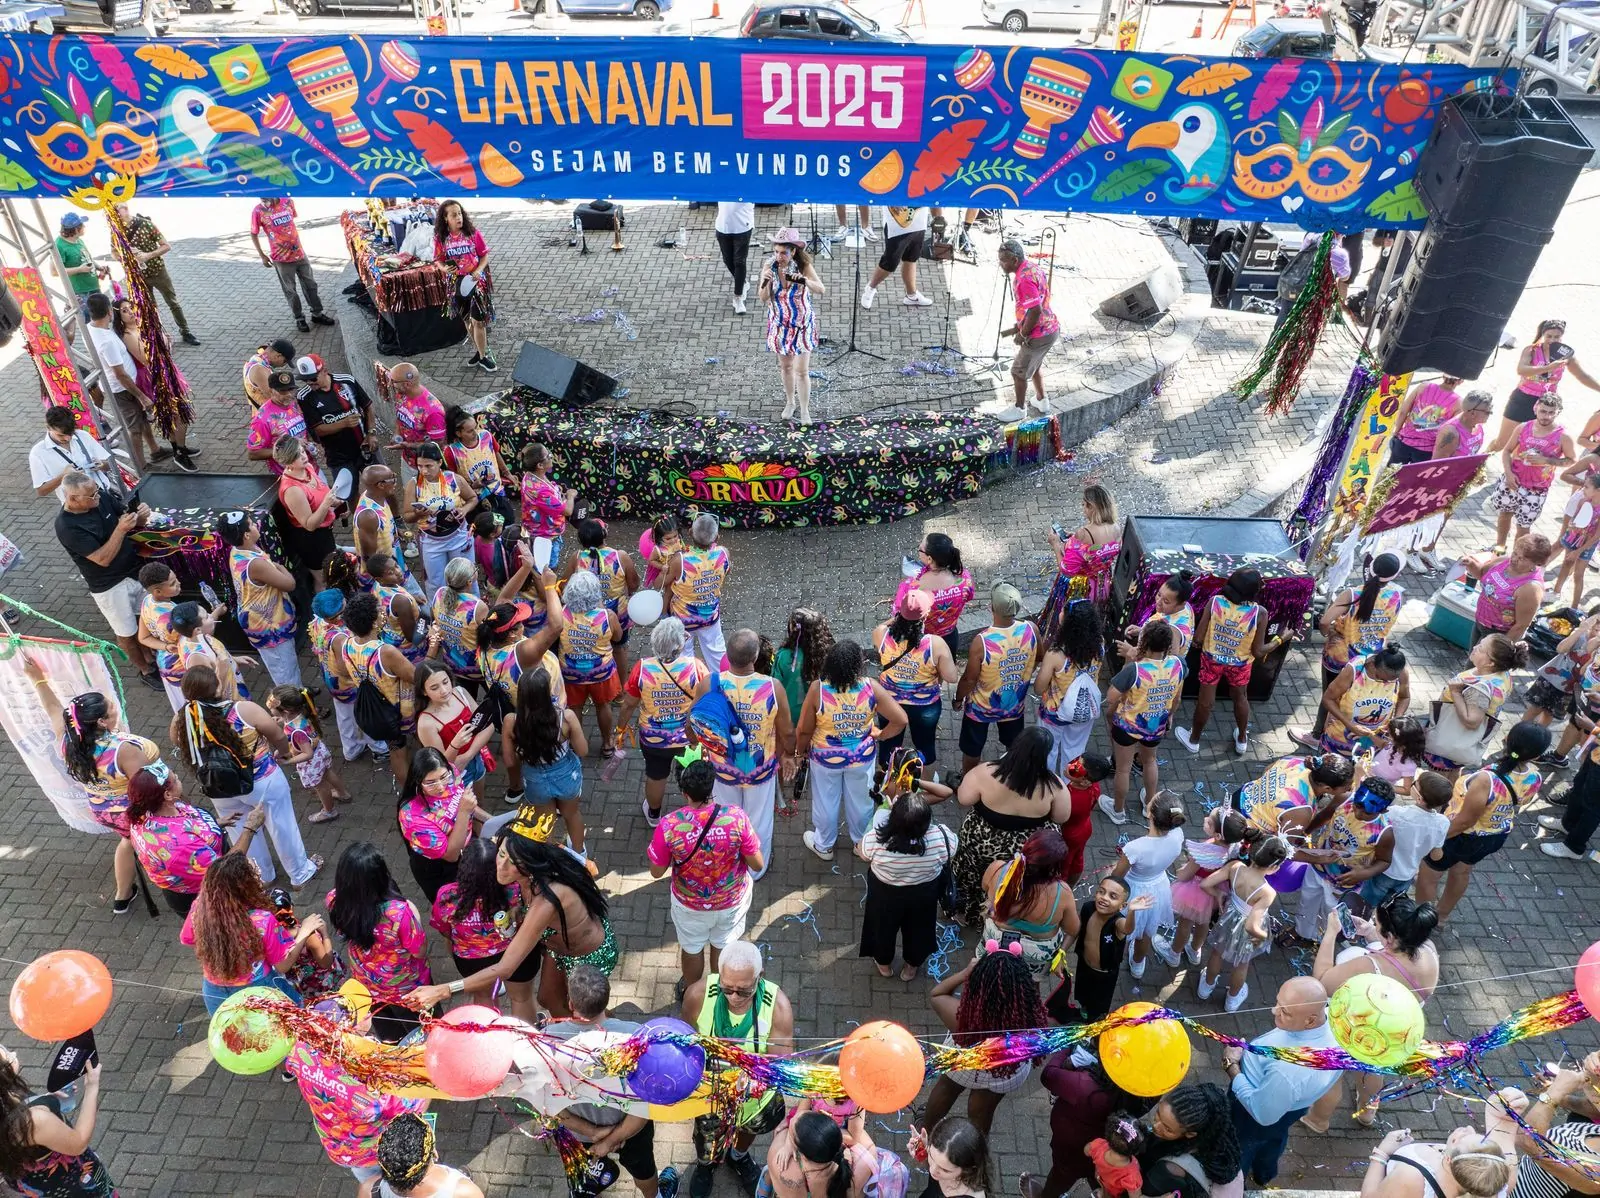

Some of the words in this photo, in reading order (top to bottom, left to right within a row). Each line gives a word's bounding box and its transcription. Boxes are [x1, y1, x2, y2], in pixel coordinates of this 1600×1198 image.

[450, 59, 733, 126] CARNAVAL
[760, 61, 905, 129] 2025
[531, 149, 633, 173] SEJAM
[653, 150, 852, 177] BEM-VINDOS
[1417, 465, 1450, 479] AS
[675, 477, 815, 502] CARNAVAL
[934, 586, 962, 599] ultura
[1214, 624, 1245, 638] JUNTOS
[1213, 633, 1240, 647] SOMOS
[1215, 643, 1236, 655] MAIS
[653, 698, 686, 706] SOMOS
[833, 712, 868, 722] JUNTOS
[56, 1046, 74, 1070] NÃO
[301, 1065, 349, 1096] cultura
